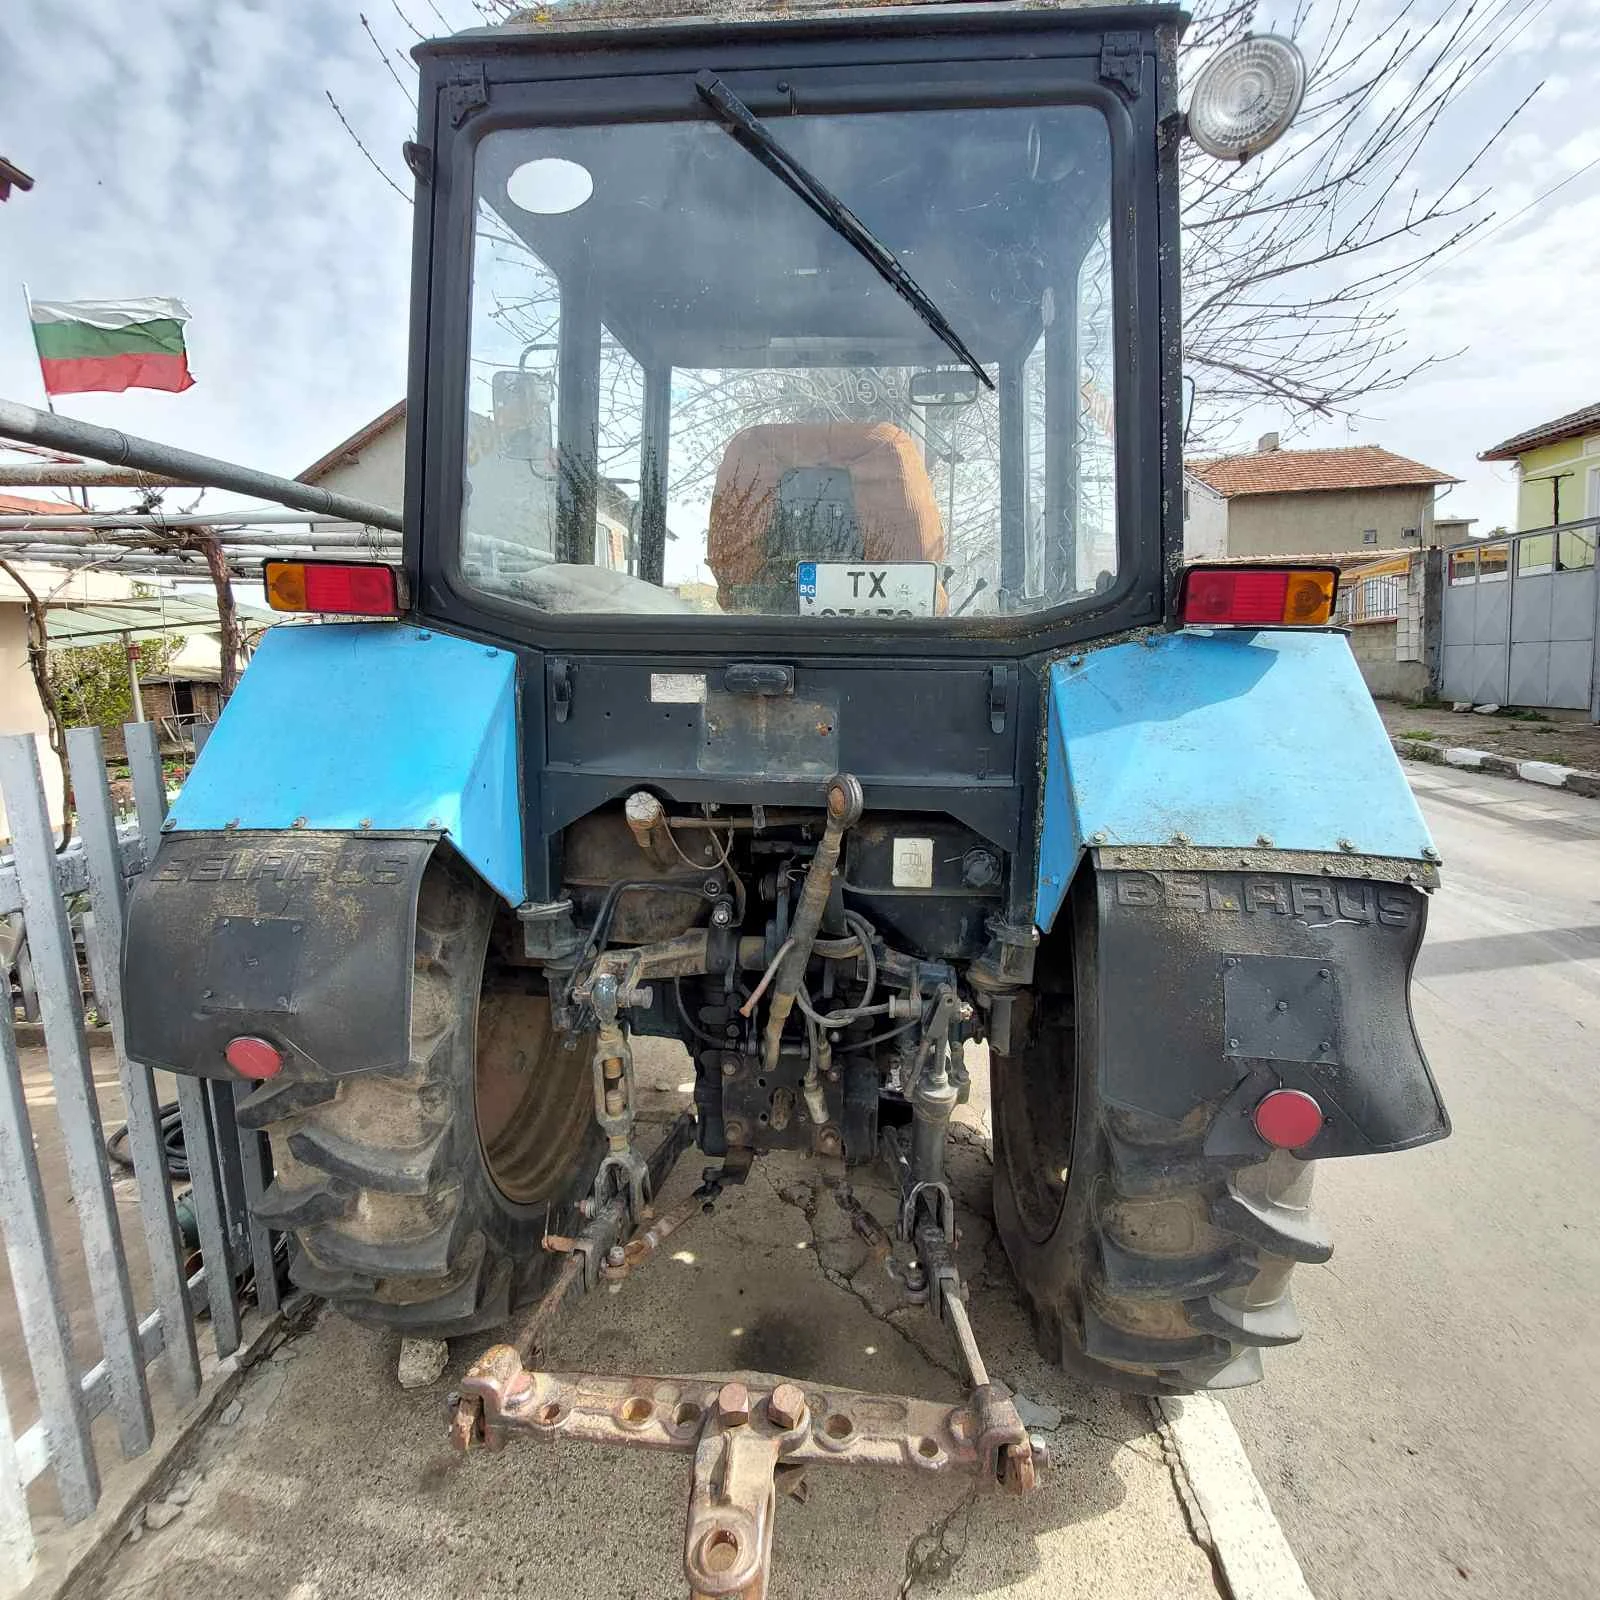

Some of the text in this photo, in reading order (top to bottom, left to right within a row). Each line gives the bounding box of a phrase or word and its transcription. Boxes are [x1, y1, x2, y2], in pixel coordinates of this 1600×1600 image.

[800, 584, 815, 594] BG
[847, 571, 887, 598] TX
[1116, 870, 1412, 928] BELARUS
